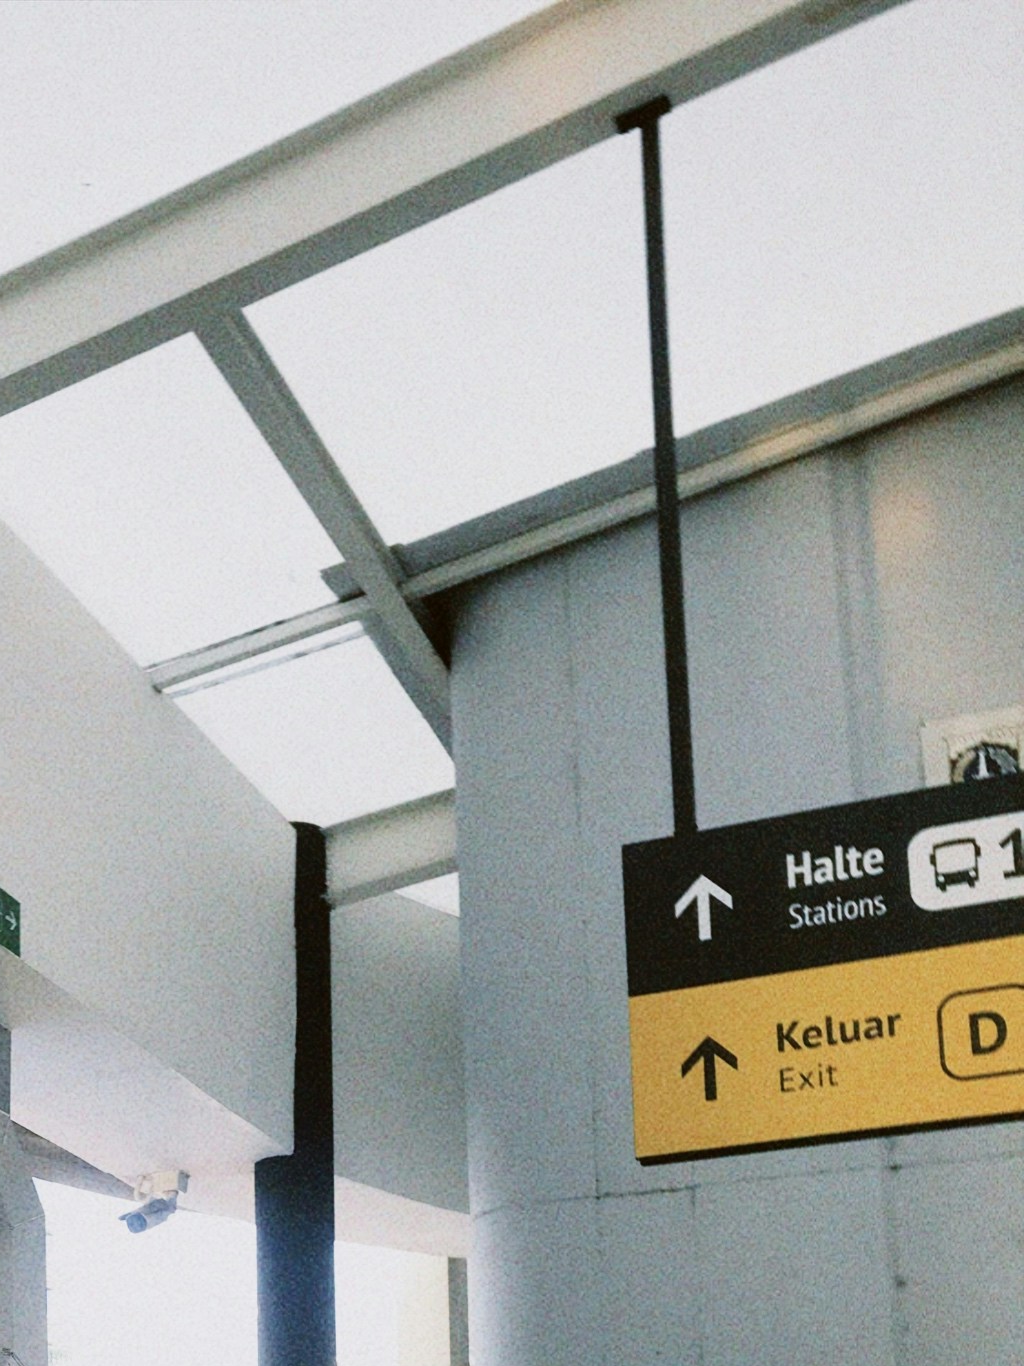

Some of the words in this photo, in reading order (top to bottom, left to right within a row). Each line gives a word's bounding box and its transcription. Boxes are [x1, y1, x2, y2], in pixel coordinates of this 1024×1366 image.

[786, 846, 885, 889] Halte
[789, 894, 887, 929] Stations
[776, 1012, 901, 1054] Keluar
[968, 1011, 1008, 1056] D
[780, 1063, 838, 1093] Exit
